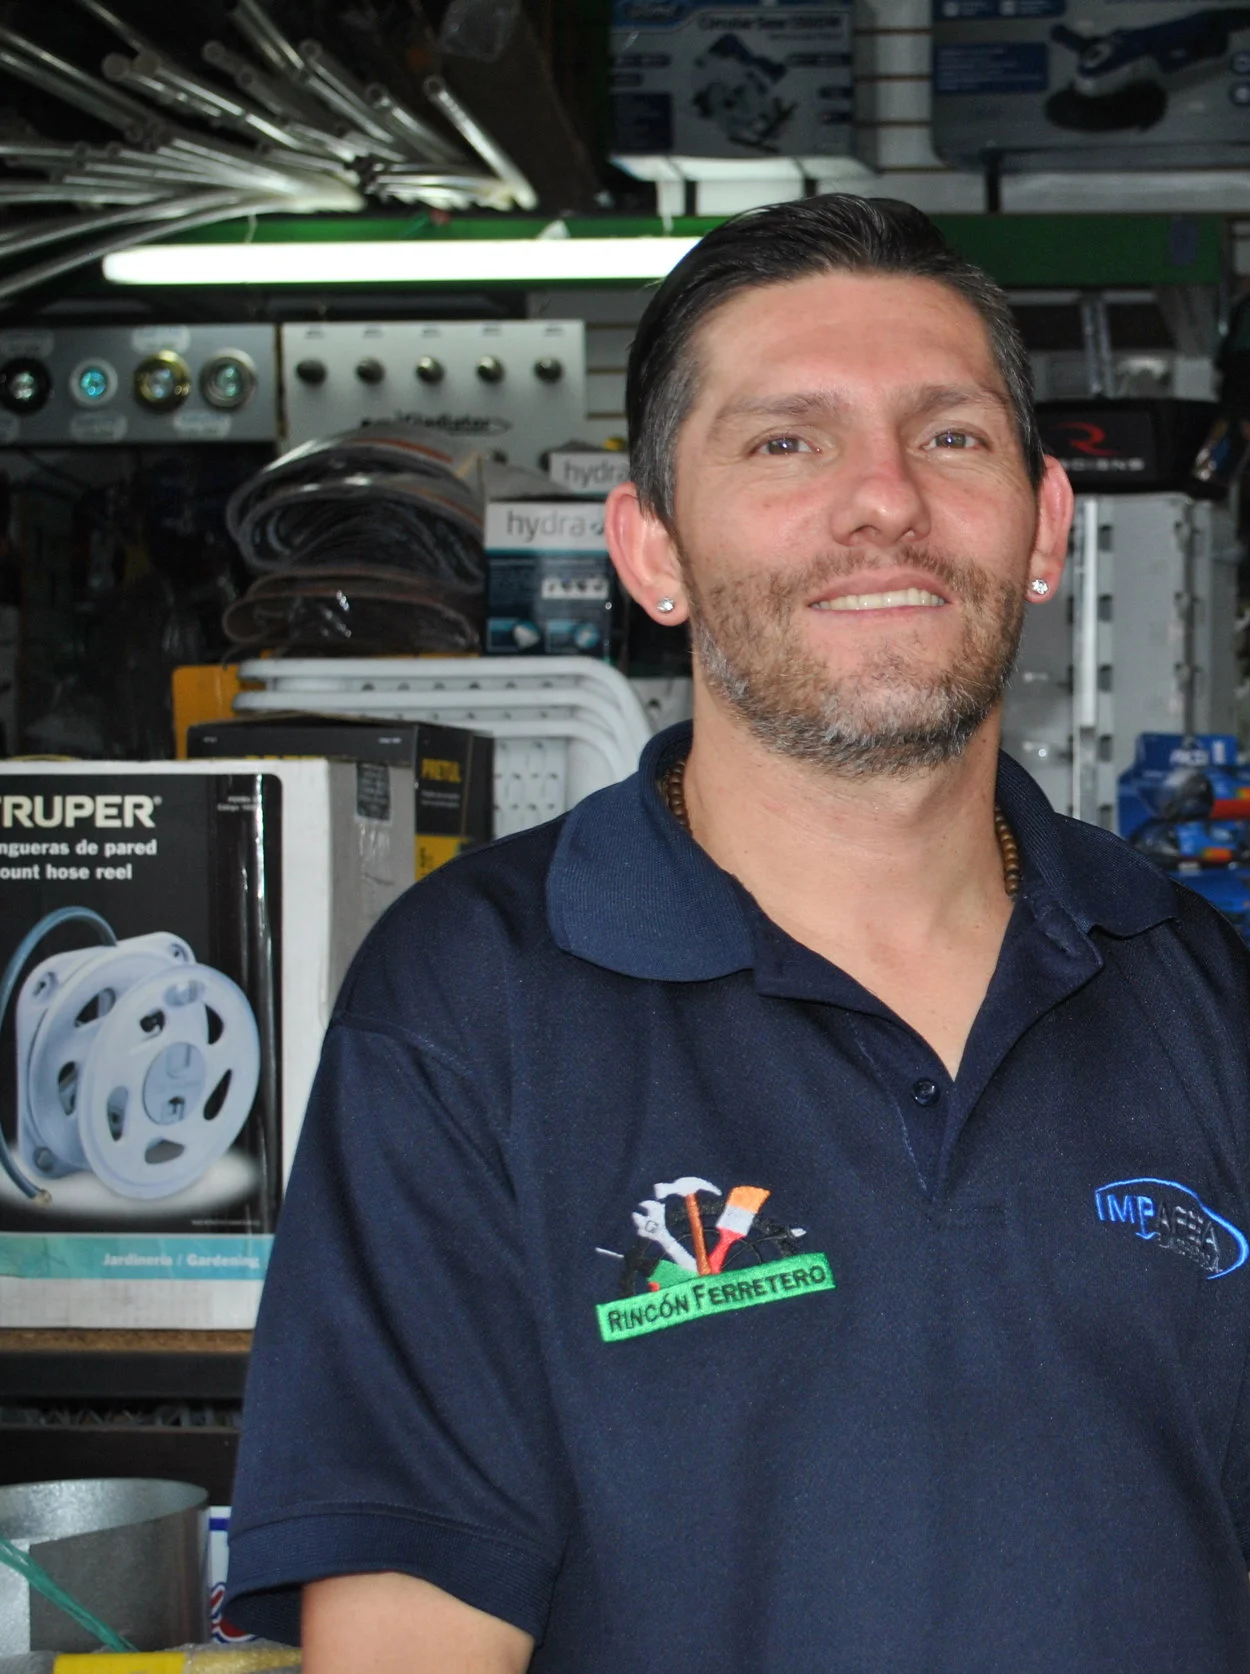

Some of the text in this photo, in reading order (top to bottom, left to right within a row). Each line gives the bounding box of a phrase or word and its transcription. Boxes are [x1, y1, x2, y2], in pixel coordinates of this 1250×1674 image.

[507, 511, 586, 543] hydra
[0, 795, 156, 828] RUPER
[75, 839, 99, 856] de
[104, 839, 157, 858] pared
[46, 863, 90, 880] hose
[96, 863, 133, 880] reel
[186, 1253, 260, 1269] Gardening
[608, 1265, 827, 1334] RINCÓN FERRETERO
